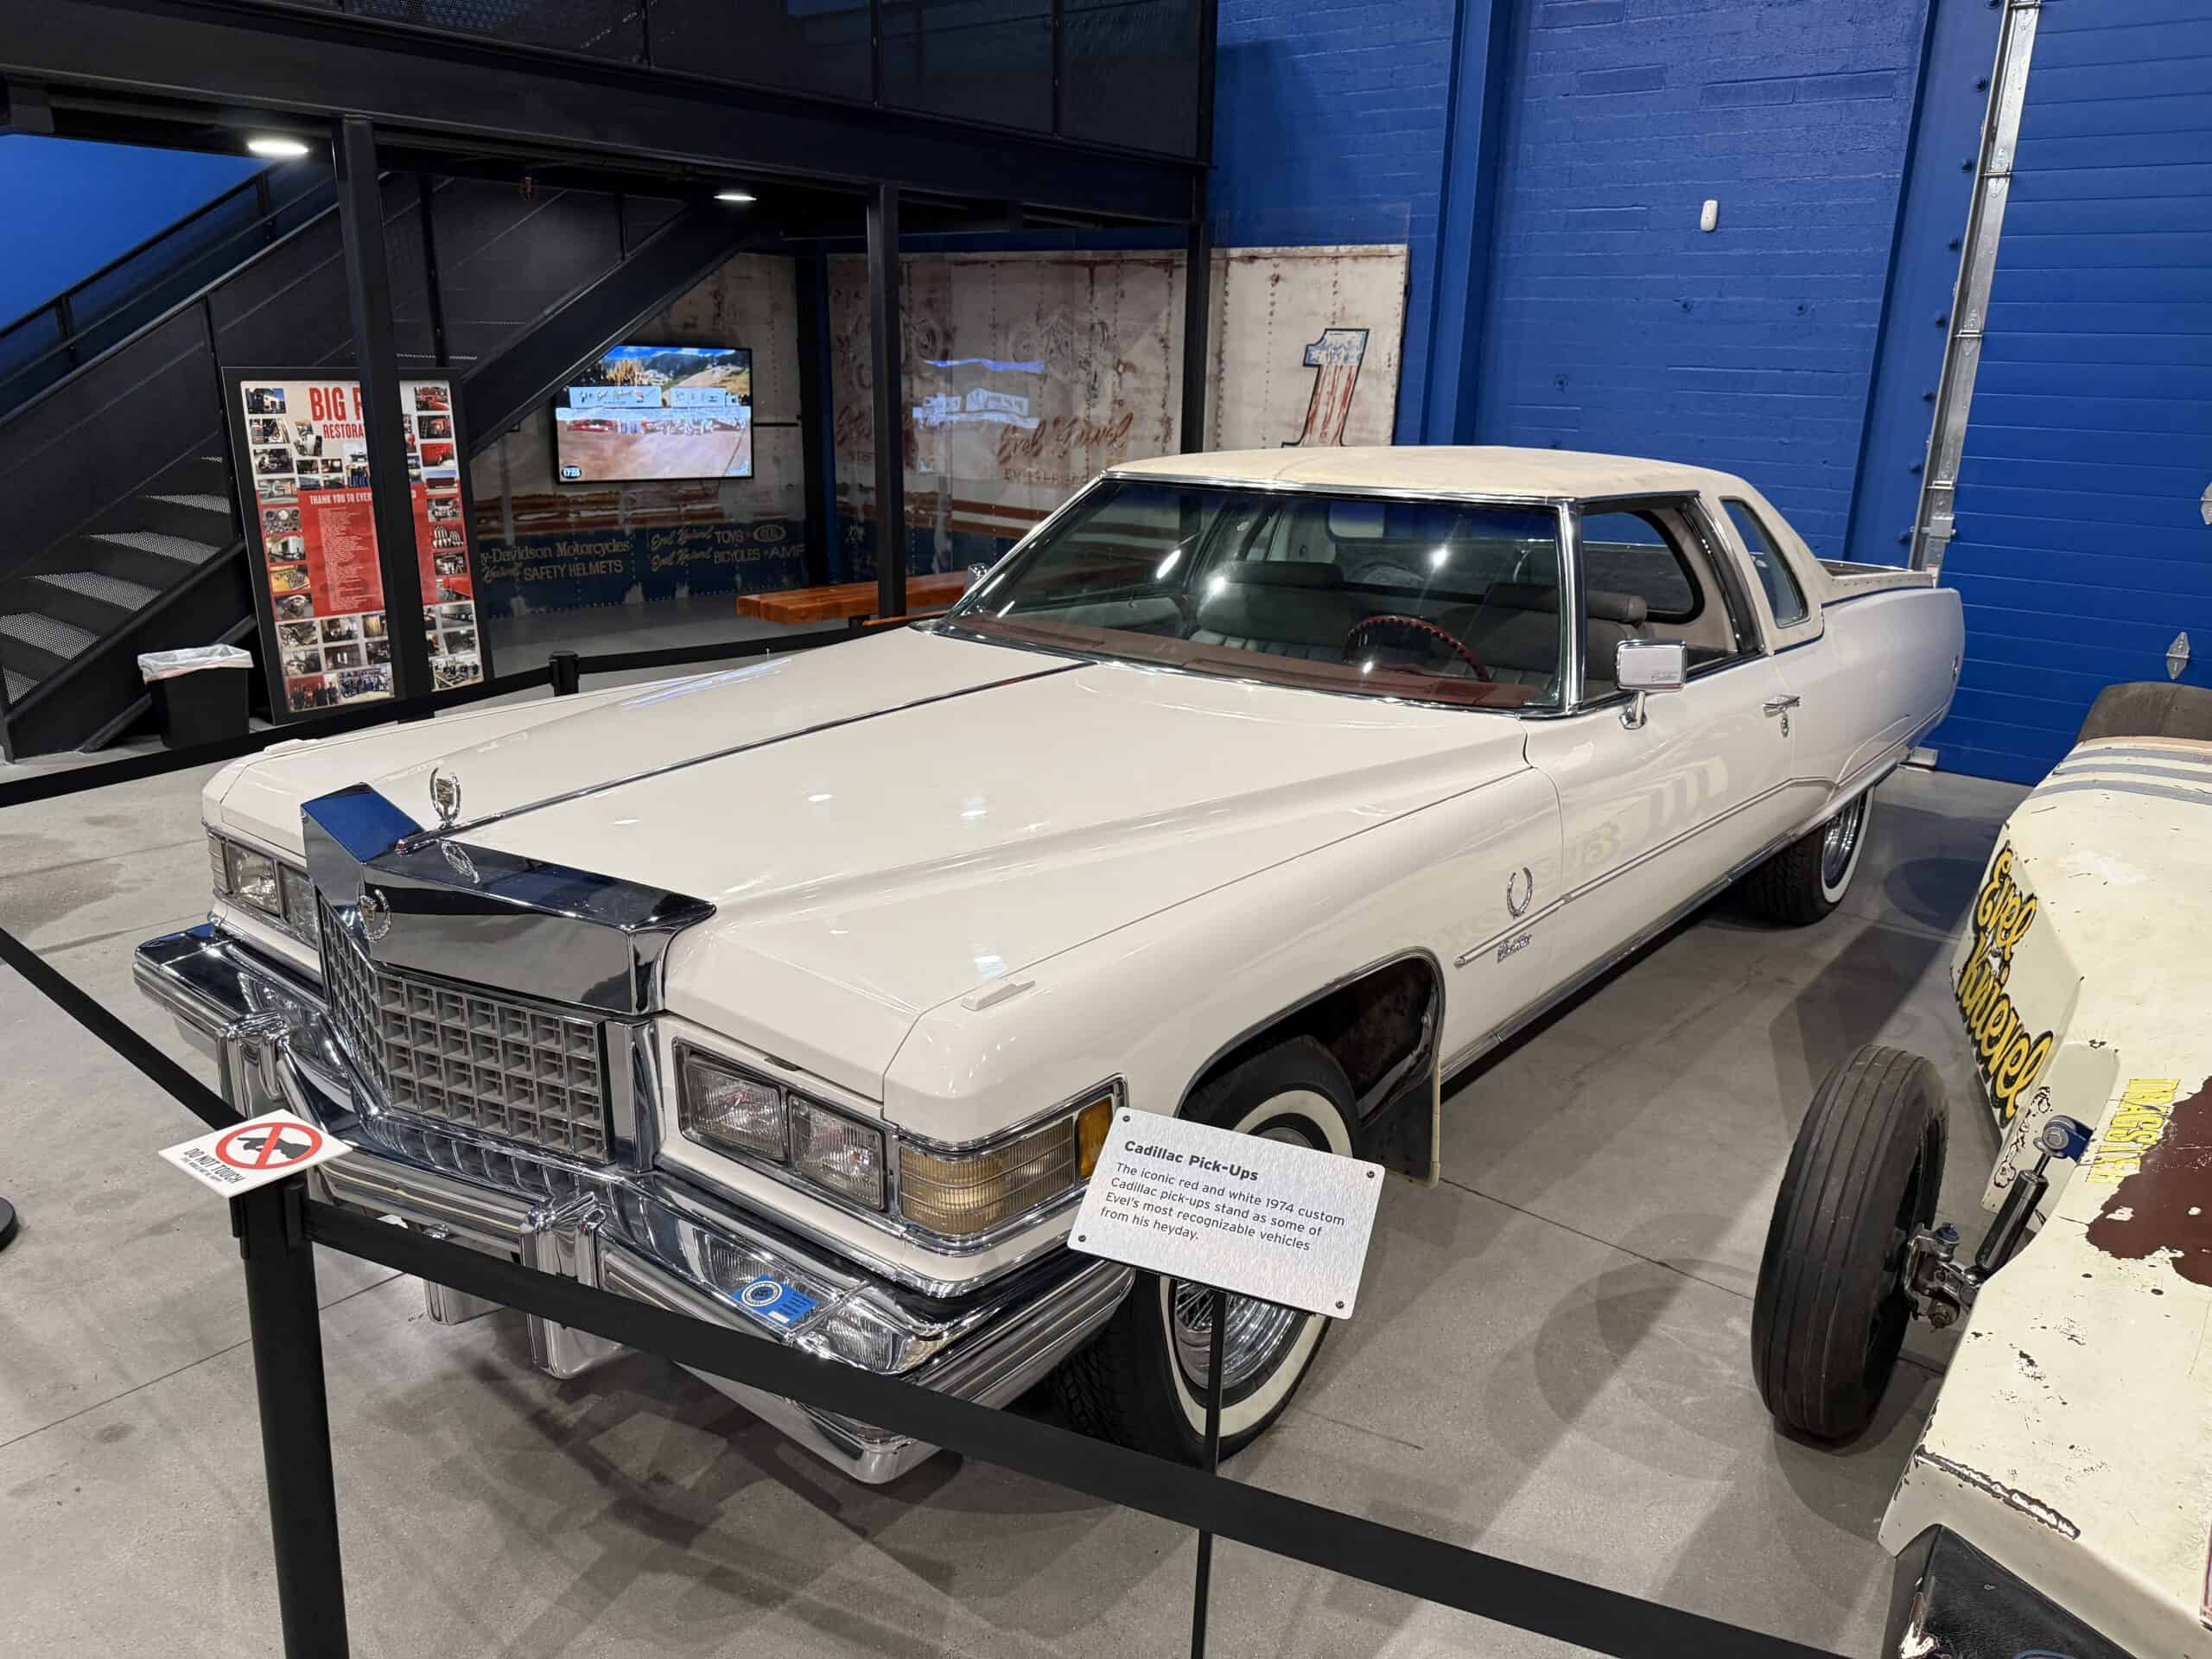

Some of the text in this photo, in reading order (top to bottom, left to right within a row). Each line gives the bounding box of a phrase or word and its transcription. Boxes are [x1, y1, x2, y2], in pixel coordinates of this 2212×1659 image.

[309, 387, 346, 421] BIG
[309, 495, 331, 505] THANK
[333, 493, 345, 503] YOU
[346, 493, 354, 502] TO
[556, 539, 630, 557] Motorcycles
[714, 530, 744, 543] TOYS
[524, 564, 568, 581] SAFETY
[569, 560, 623, 576] HELMETS
[714, 549, 760, 563] BICYCLES
[1973, 842, 2038, 962] Evel
[1956, 933, 2054, 1128] Knievel
[184, 1147, 204, 1158] DO
[194, 1155, 221, 1166] NOT
[211, 1165, 245, 1183] TOUCH
[1124, 1140, 1259, 1182] Cadillac Pick-Ups
[1111, 1177, 1323, 1237] Cadillac pick-ups stand as some of
[1116, 1162, 1345, 1226] The iconic red and white 1974 custom
[1100, 1206, 1199, 1241] from his heyday.
[1105, 1192, 1310, 1251] Evel's most recognizable vehicles
